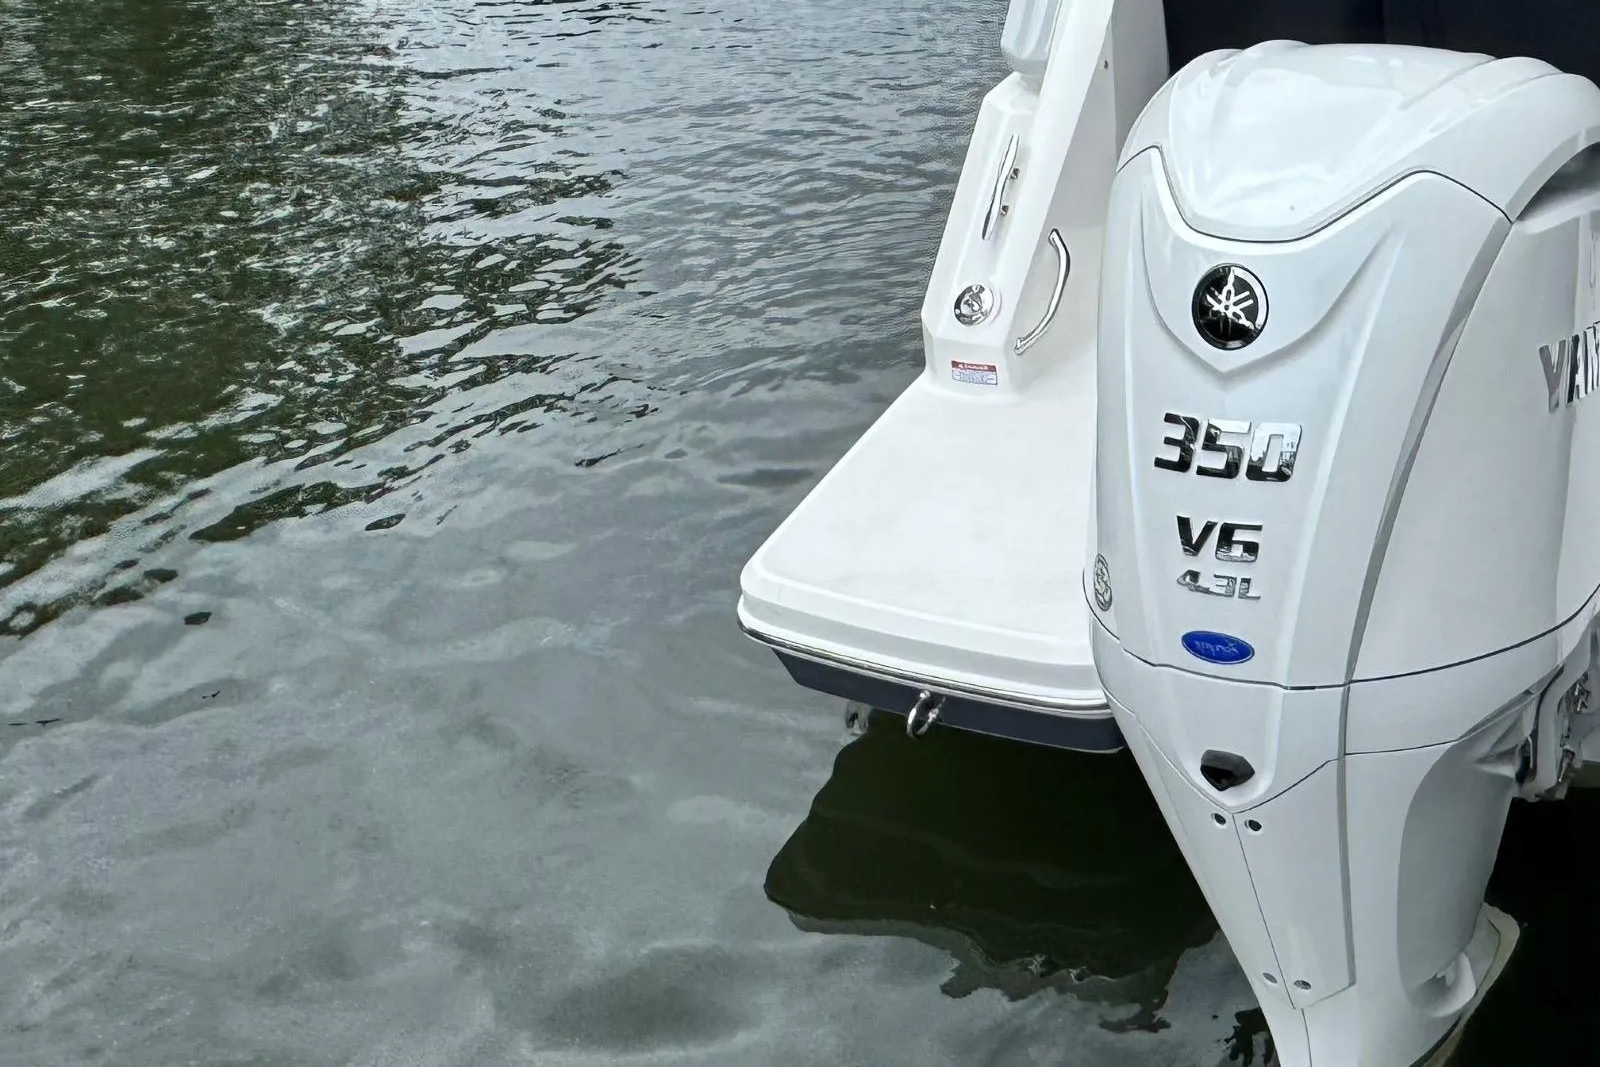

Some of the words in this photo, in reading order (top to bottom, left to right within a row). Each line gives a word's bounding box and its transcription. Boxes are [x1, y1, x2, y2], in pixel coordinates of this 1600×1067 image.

[1154, 412, 1302, 482] 350
[1177, 515, 1263, 562] V6
[1176, 569, 1261, 600] 4.3L
